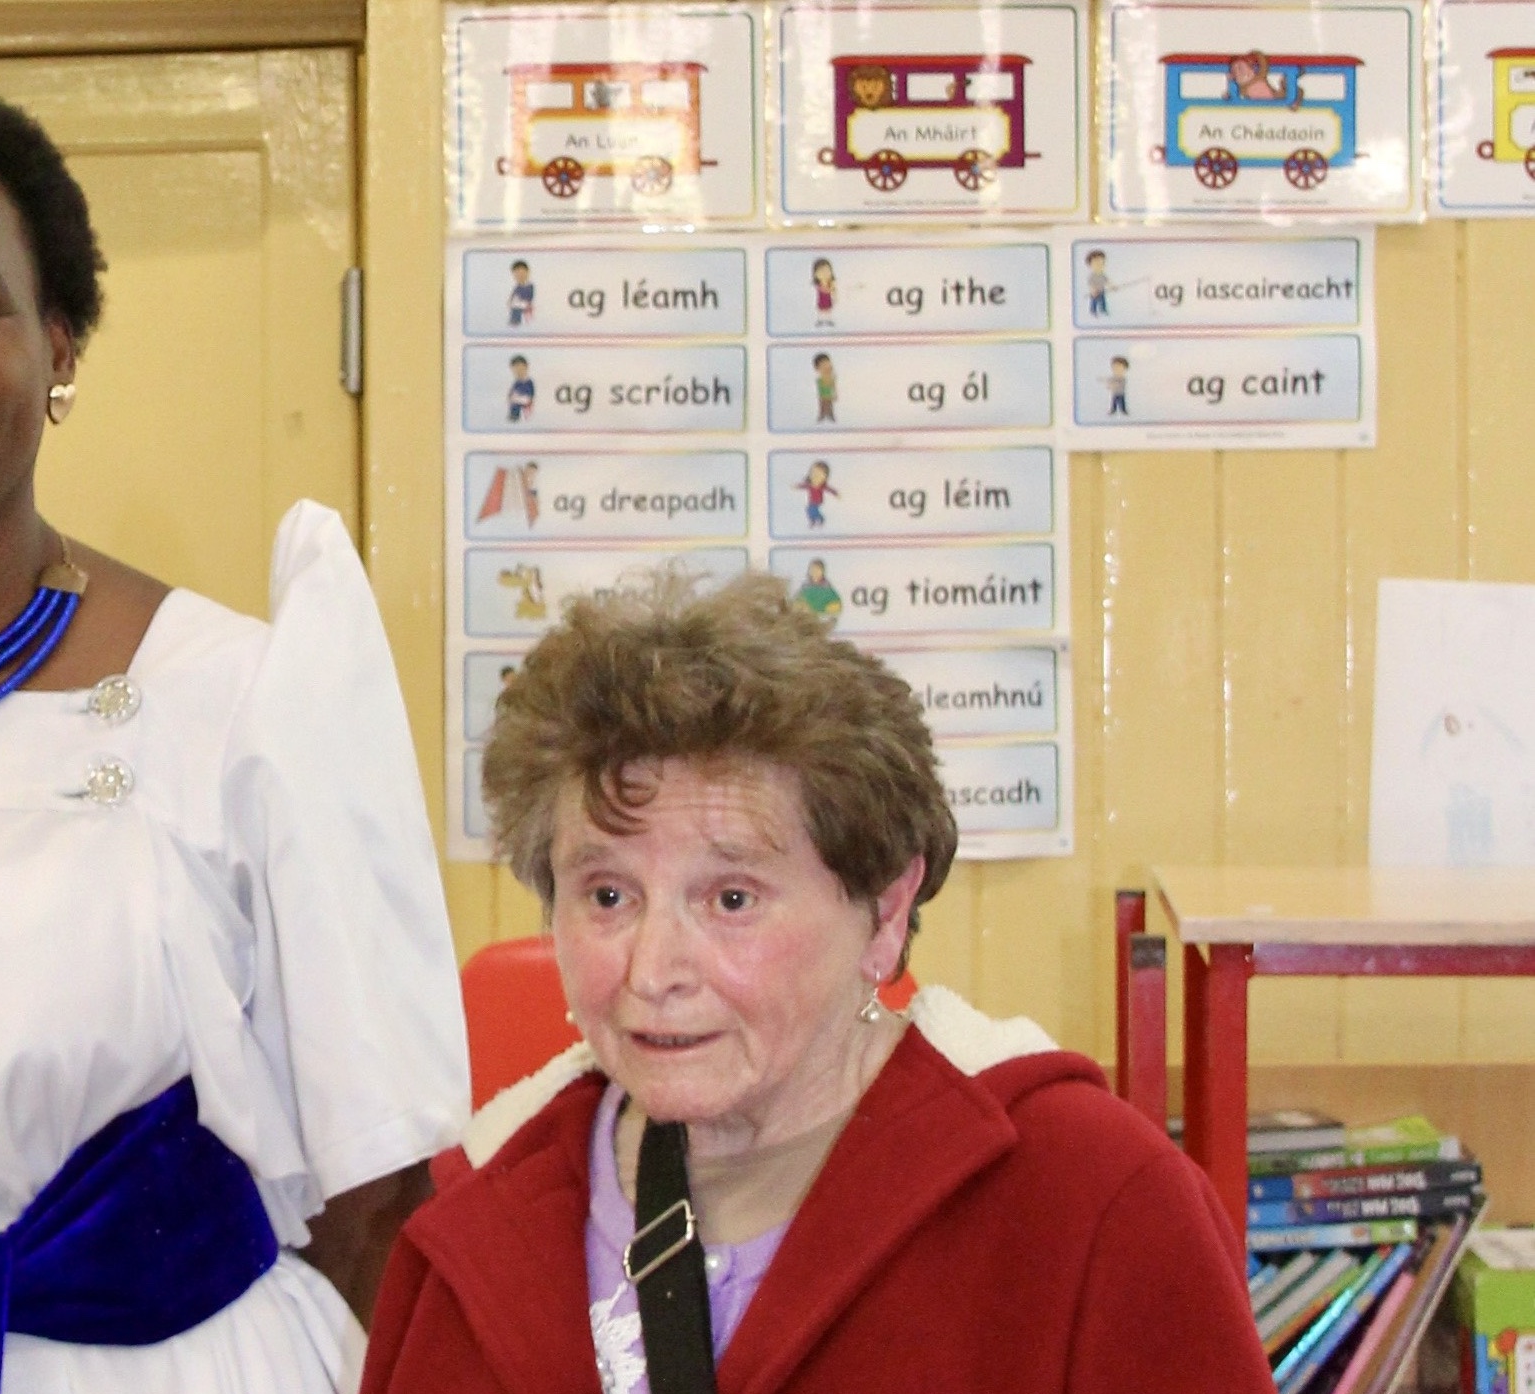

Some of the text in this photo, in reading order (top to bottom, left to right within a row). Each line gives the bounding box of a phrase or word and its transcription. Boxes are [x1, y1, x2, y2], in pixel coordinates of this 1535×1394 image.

[566, 134, 590, 149] An
[884, 125, 908, 142] An
[1198, 124, 1224, 140] An
[567, 279, 720, 318] ag léamh
[886, 276, 1006, 316] ag ithe
[1154, 275, 1354, 307] ag iascaireacht
[554, 375, 732, 414] ag scríobh
[907, 370, 989, 413] ag ól
[1186, 367, 1326, 405] ag caint
[553, 486, 736, 521] ag dreapadh
[889, 478, 1011, 519] ag léim
[850, 574, 1044, 616] ag tiomáint
